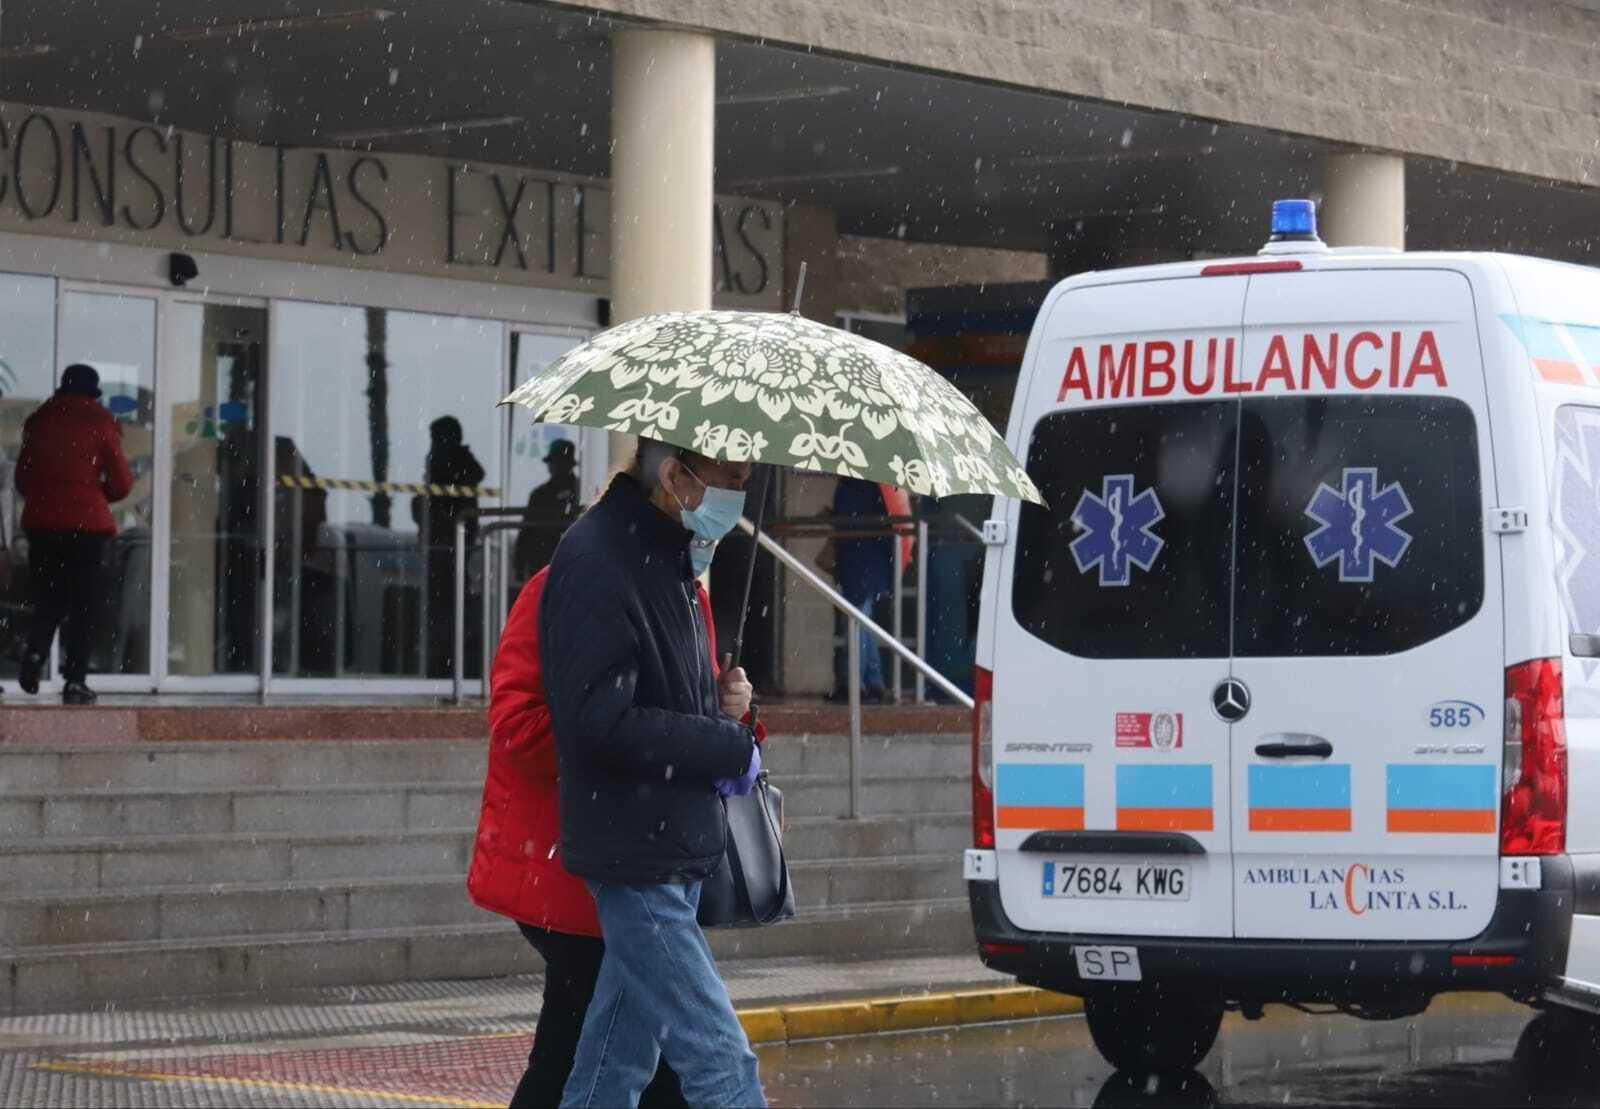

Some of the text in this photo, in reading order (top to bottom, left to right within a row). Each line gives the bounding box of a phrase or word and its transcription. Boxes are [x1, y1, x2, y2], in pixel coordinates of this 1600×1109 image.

[0, 113, 389, 255] ONSULTAS
[1057, 330, 1448, 402] AMBULANCIA
[1429, 707, 1471, 727] 585
[1061, 866, 1184, 895] 7684 KWG
[1243, 863, 1404, 892] AMBULANCIAS
[1309, 891, 1338, 909] LA
[1427, 891, 1468, 910] S.L.
